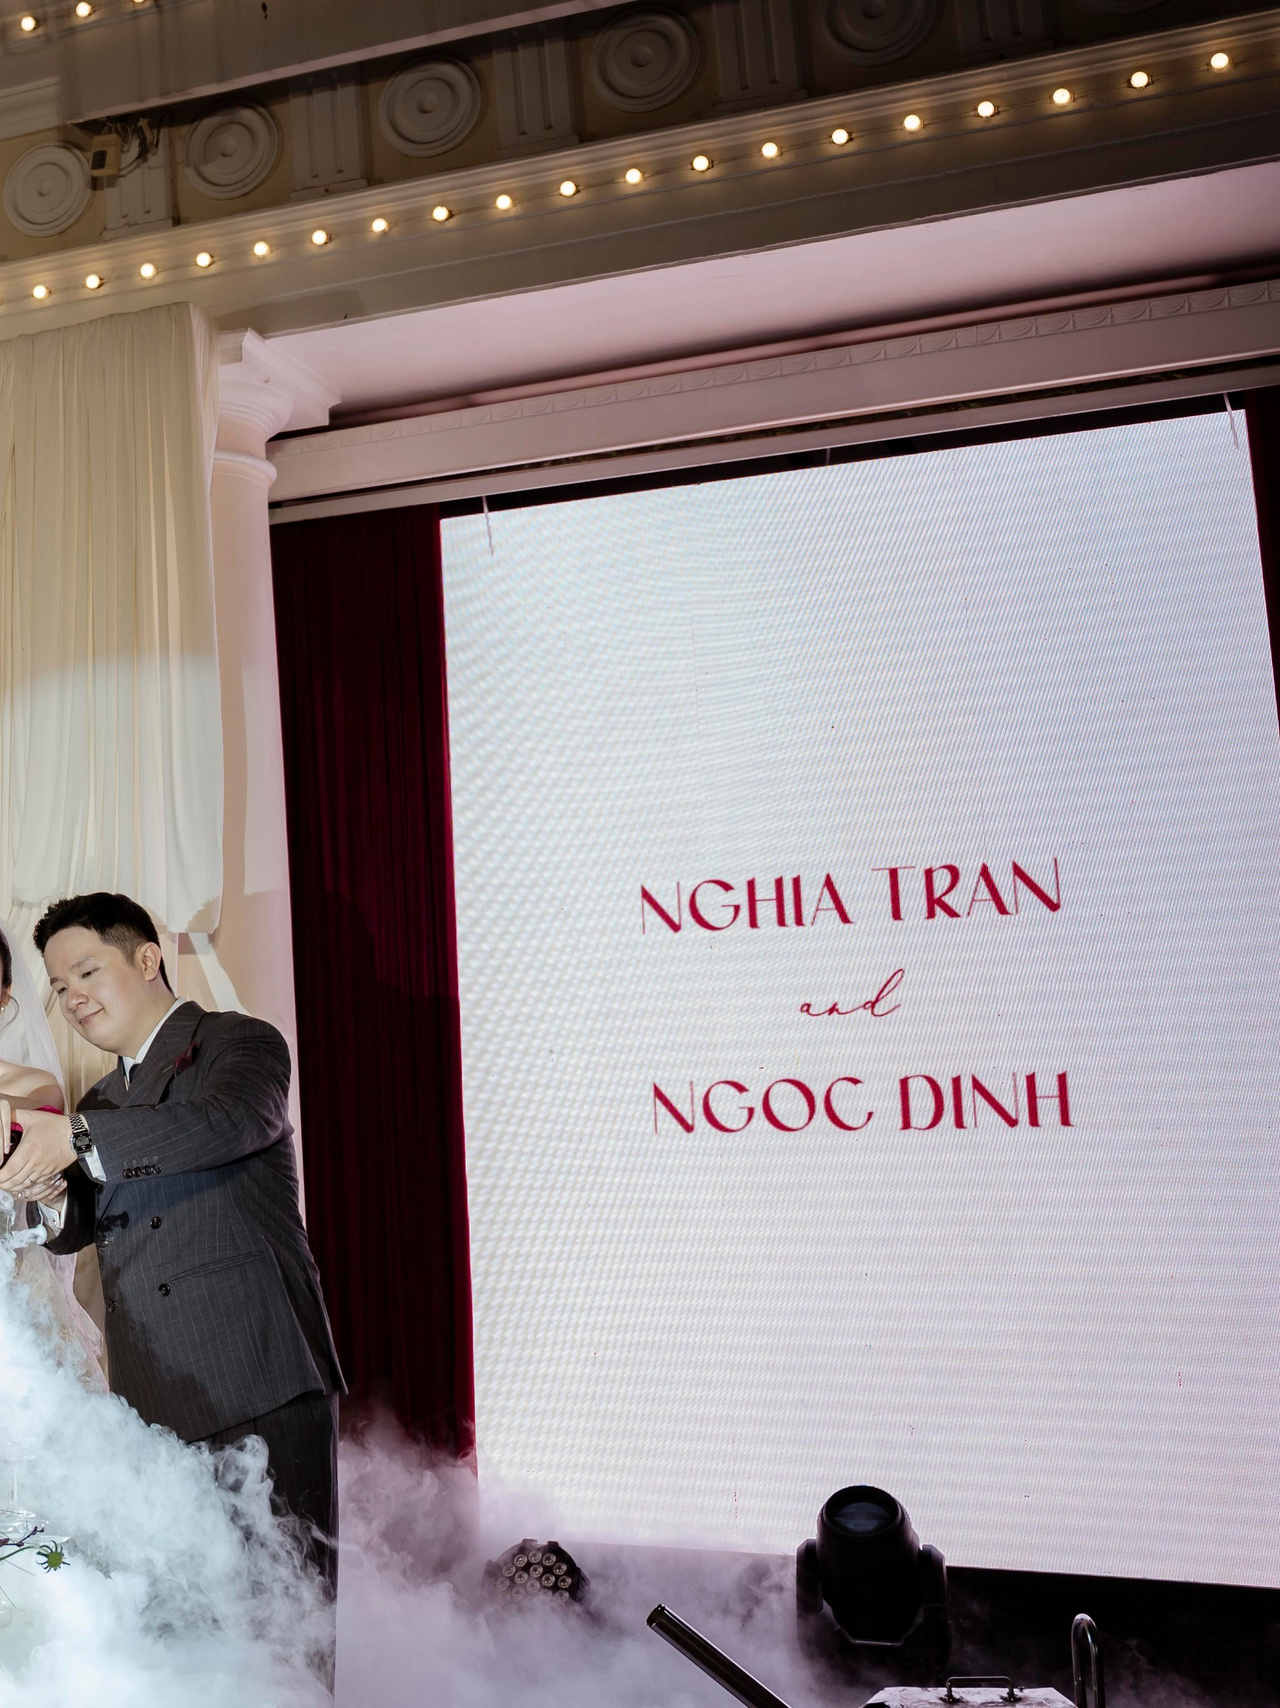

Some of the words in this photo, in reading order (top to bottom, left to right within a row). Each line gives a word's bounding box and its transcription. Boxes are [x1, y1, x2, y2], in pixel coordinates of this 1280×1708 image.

[640, 872, 854, 935] NGHIA
[871, 857, 1061, 922] TRAN
[800, 968, 905, 1017] and
[653, 1076, 874, 1134] NGOC
[899, 1070, 1075, 1131] DINH
